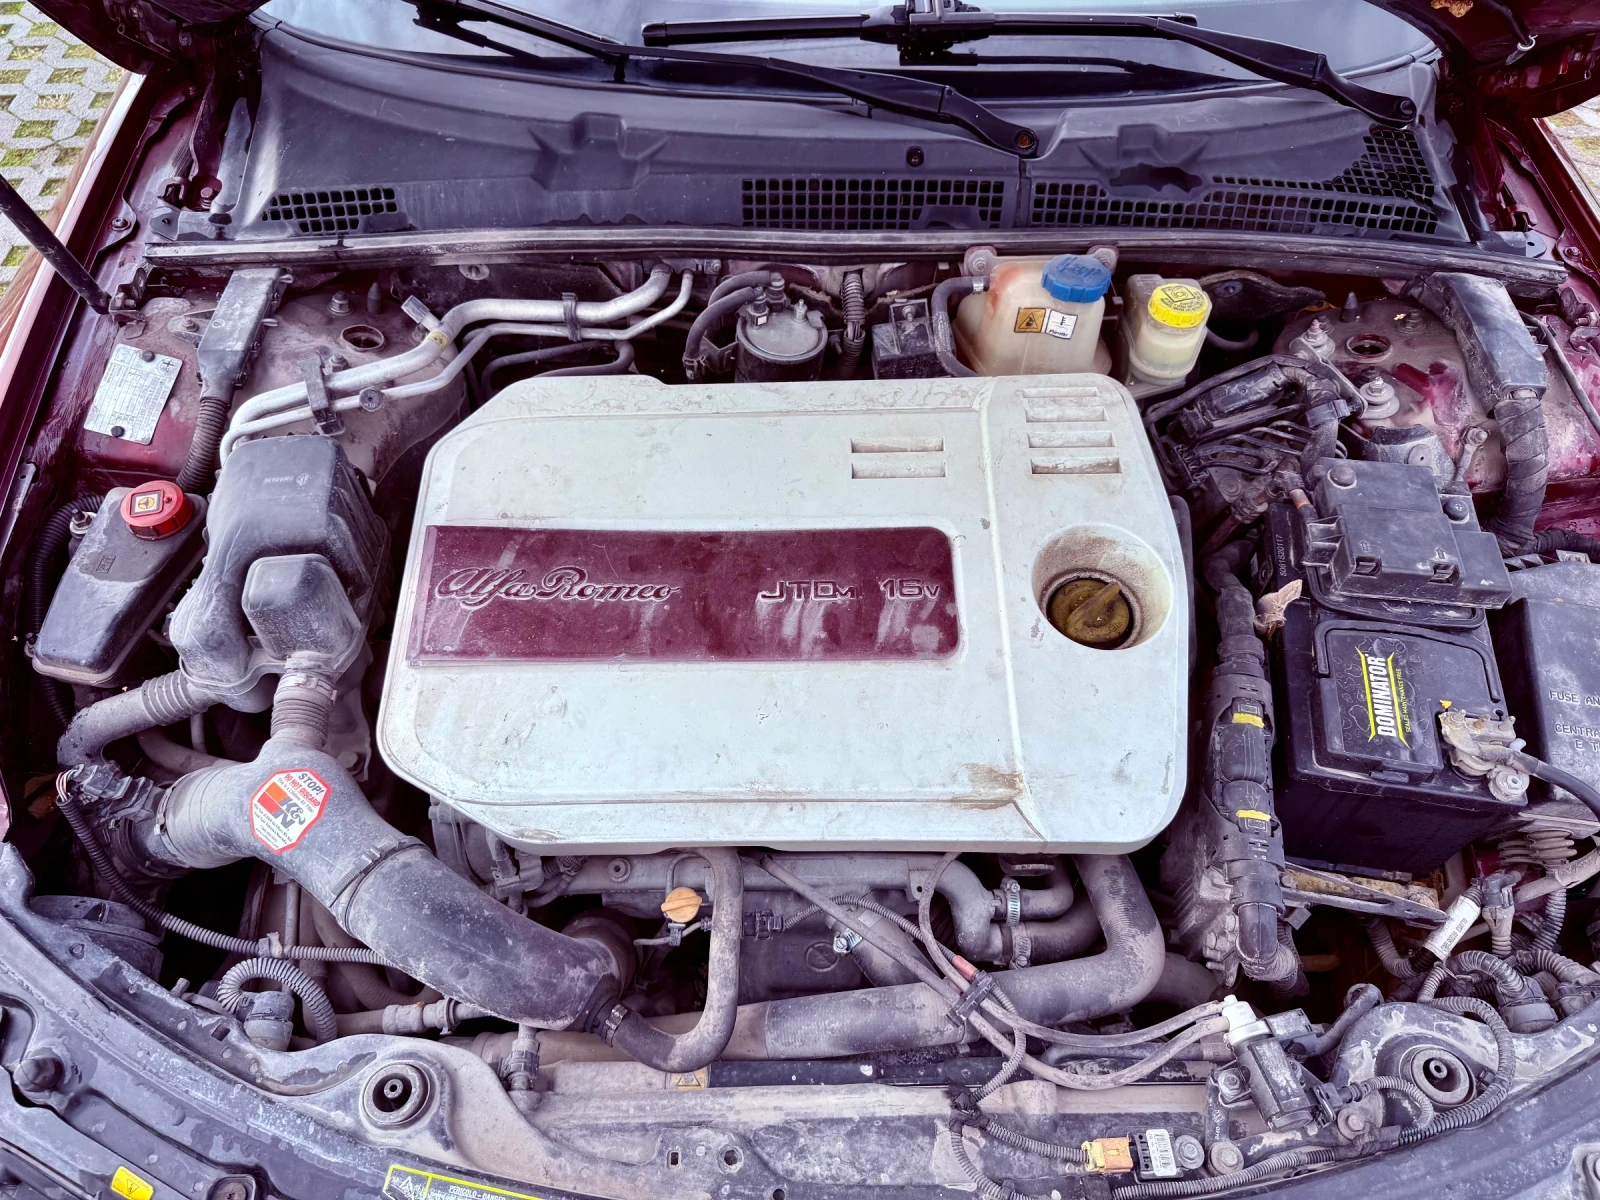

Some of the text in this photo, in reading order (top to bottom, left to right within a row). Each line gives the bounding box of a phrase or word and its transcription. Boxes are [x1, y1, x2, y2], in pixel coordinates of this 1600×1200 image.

[435, 565, 681, 610] Alfa Romeo
[1367, 656, 1396, 737] DOMINATOR
[1549, 690, 1580, 704] FUSE
[290, 779, 302, 790] NOT
[300, 788, 320, 807] DISCARD
[298, 773, 324, 795] STOP!
[448, 1184, 478, 1198] PERICOLO
